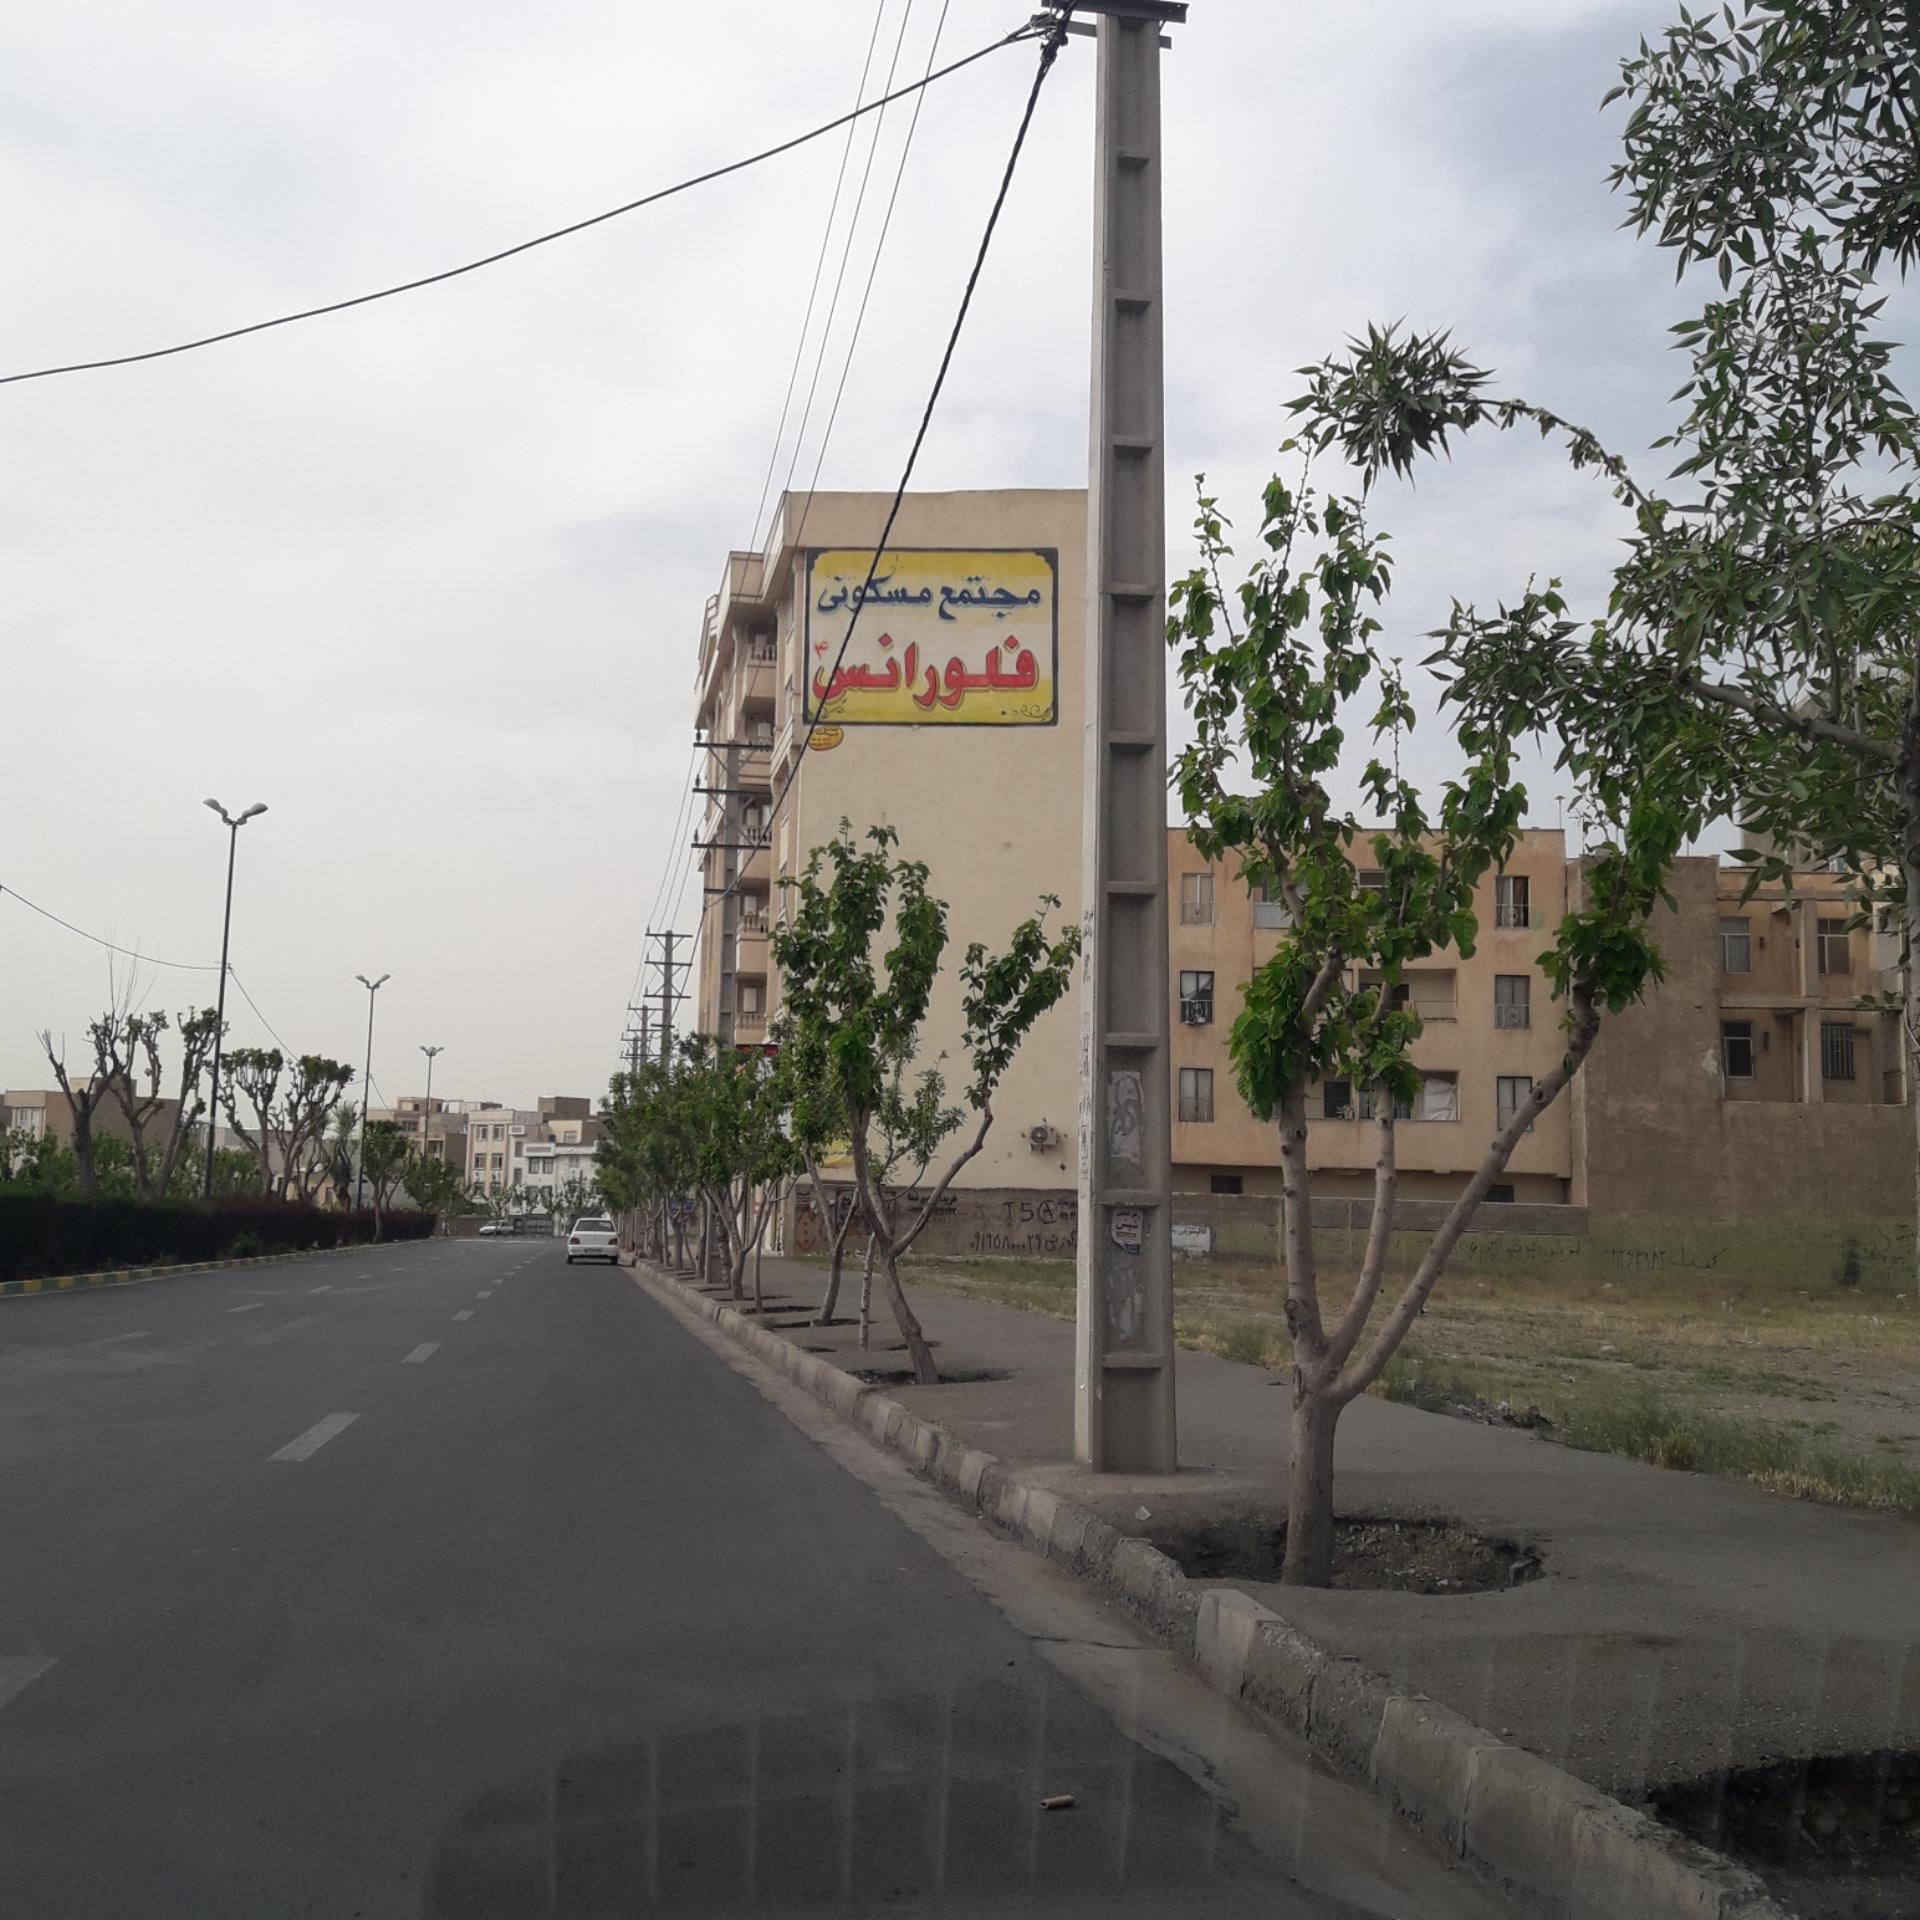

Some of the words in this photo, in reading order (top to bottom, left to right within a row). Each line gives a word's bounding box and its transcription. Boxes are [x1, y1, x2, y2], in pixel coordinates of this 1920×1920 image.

[816, 574, 932, 613] مسکونی
[938, 576, 1042, 621] مجتمع
[813, 632, 1039, 711] فلورانس
